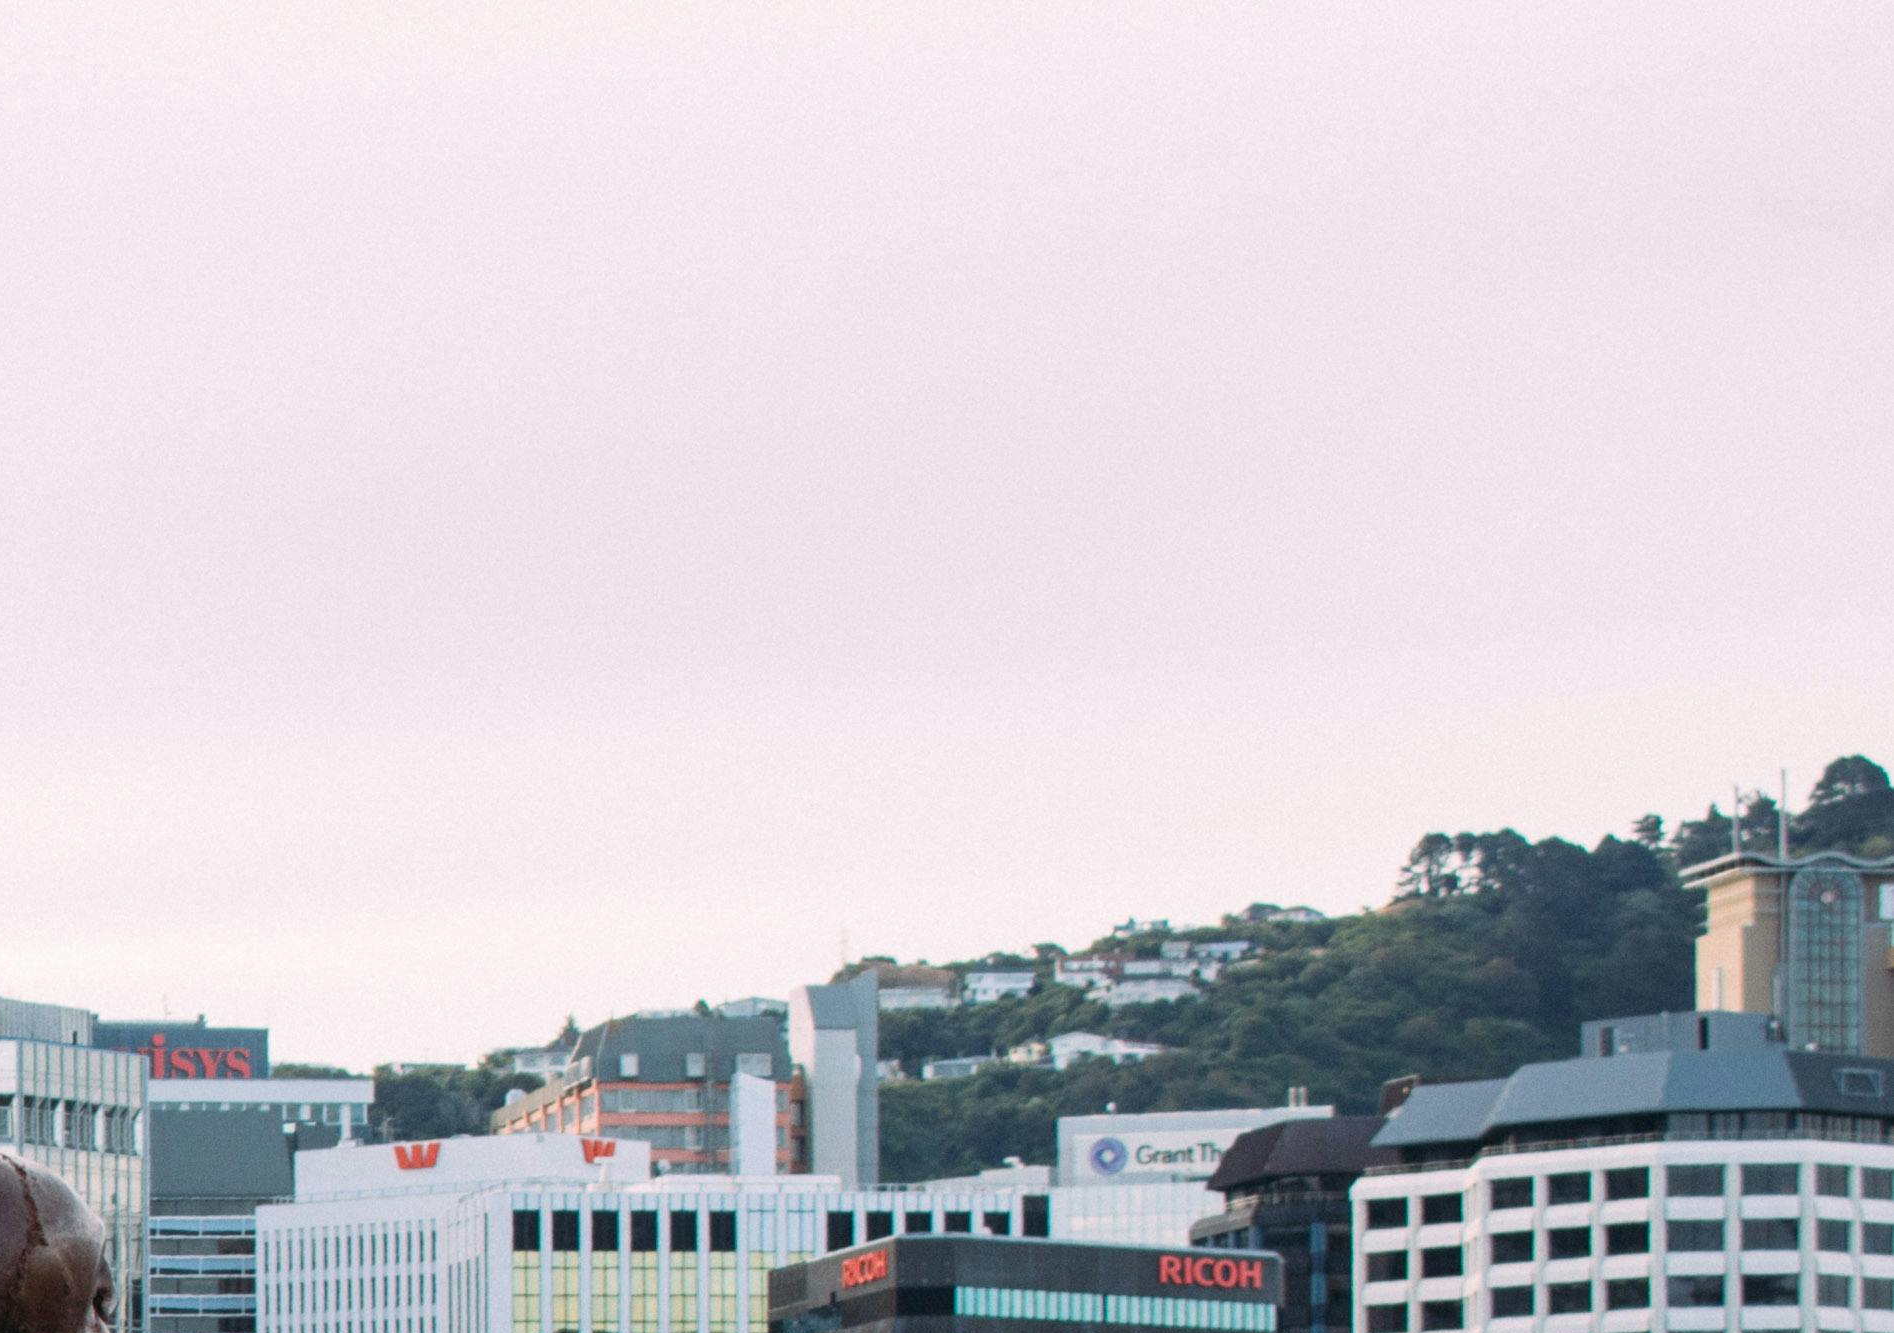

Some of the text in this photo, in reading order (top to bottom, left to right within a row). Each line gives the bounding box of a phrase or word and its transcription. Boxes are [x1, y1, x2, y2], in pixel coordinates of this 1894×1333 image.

[1136, 1141, 1227, 1165] Grant Th
[842, 1248, 889, 1290] RICOH
[1158, 1255, 1263, 1289] RICOH
